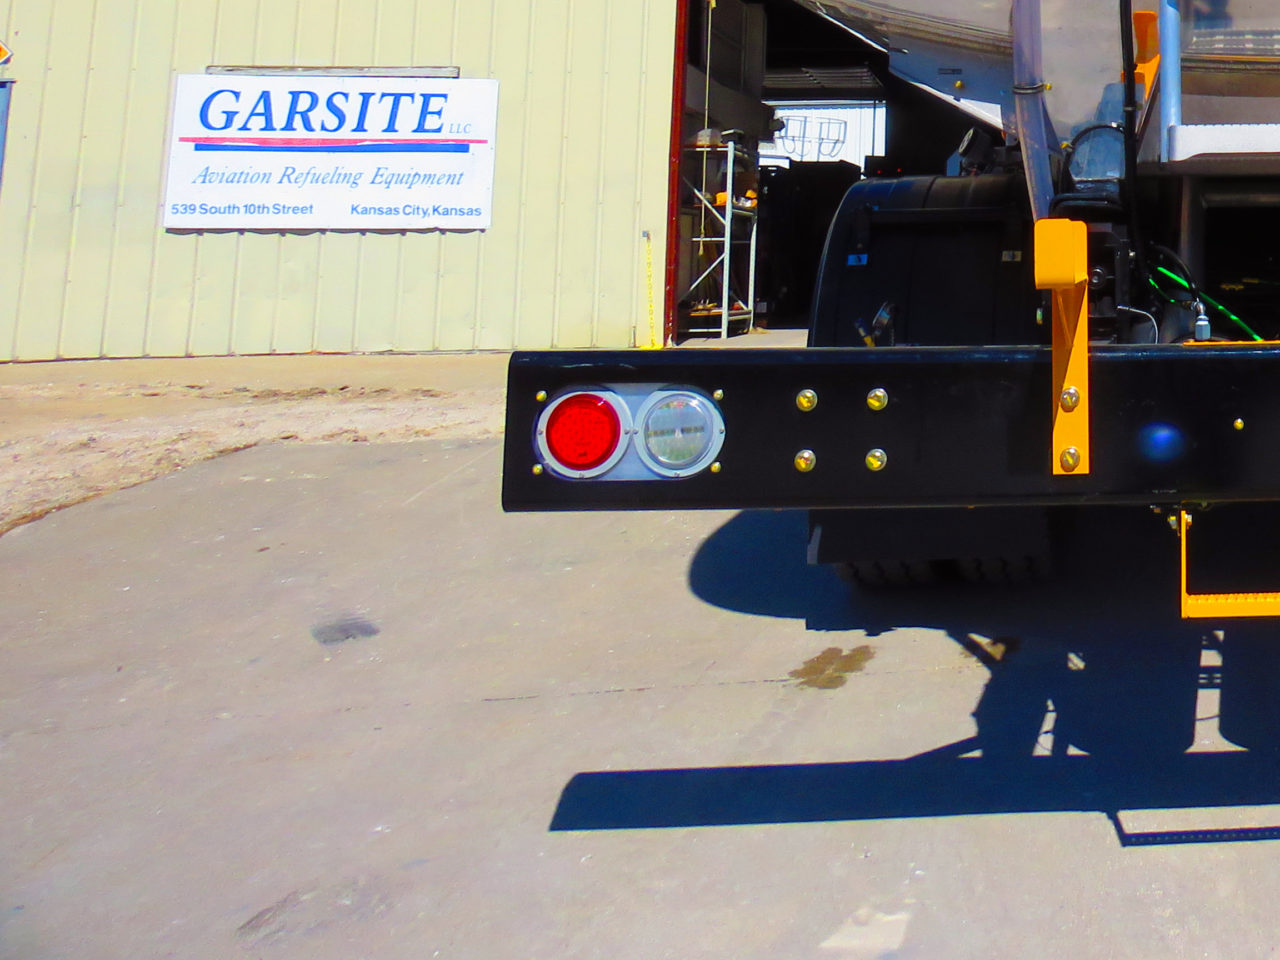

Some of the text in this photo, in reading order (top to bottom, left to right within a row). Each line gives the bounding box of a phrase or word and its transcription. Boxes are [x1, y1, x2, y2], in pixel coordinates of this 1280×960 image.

[199, 89, 471, 134] GARSITE LLC
[192, 165, 464, 189] Aviation Refueling Equipment
[171, 203, 313, 215] 539 South 10th Street
[350, 204, 482, 218] Kansas City, Kansas
